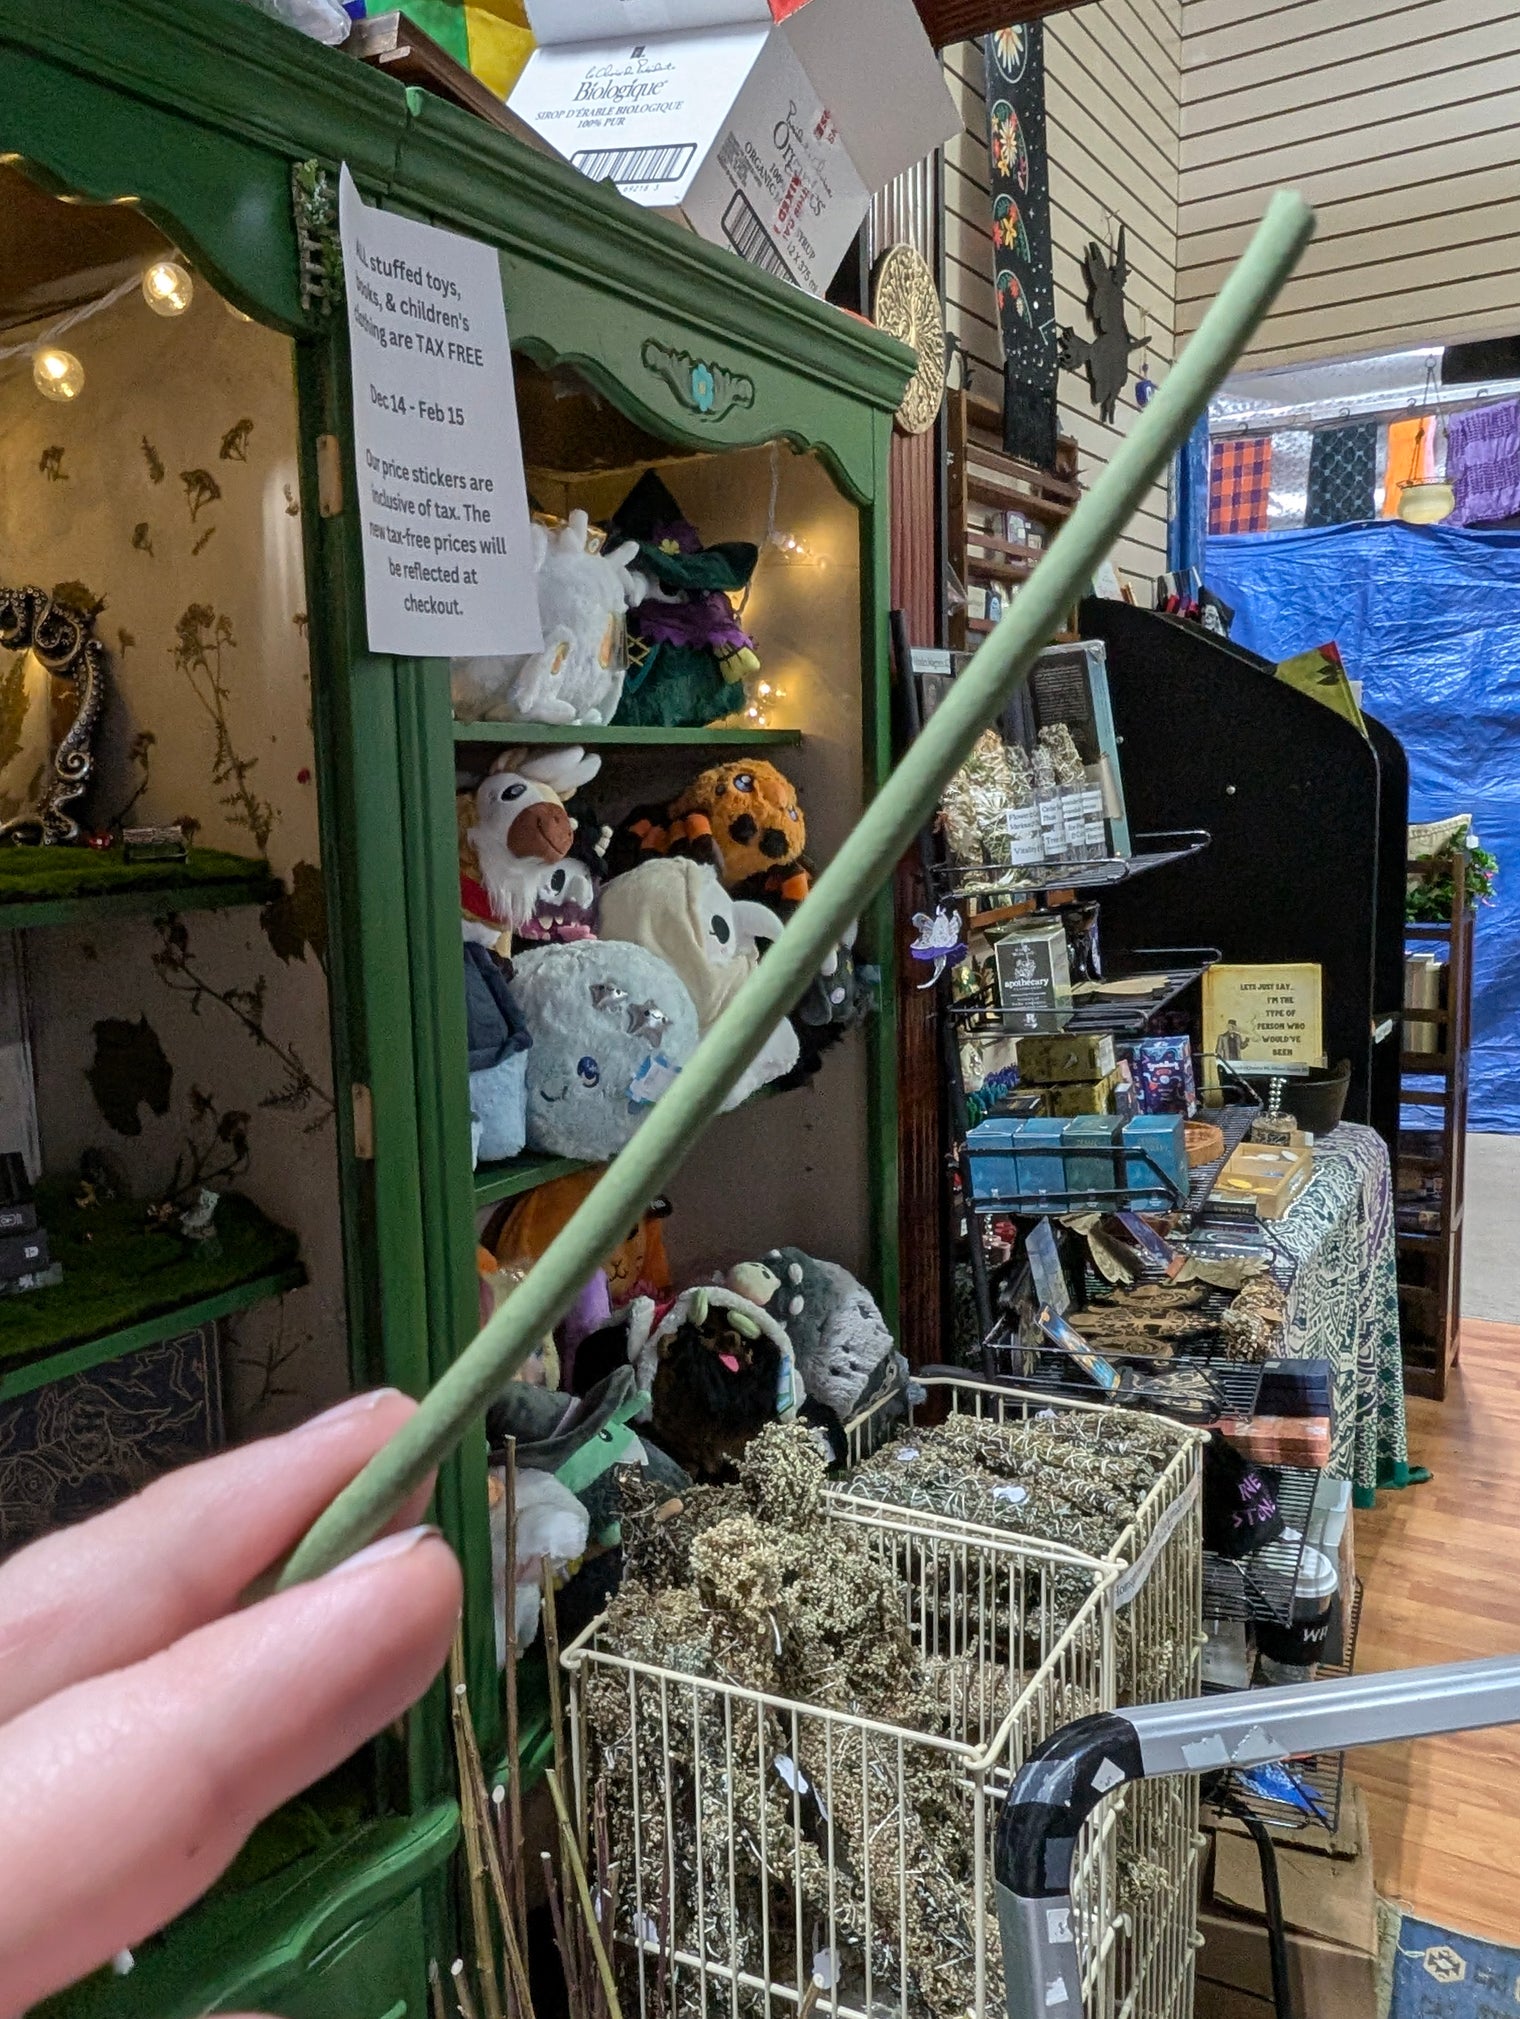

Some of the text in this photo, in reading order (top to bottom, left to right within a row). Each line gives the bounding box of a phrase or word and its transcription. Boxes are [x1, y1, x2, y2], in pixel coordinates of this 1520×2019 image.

[535, 100, 685, 120] SIROP D'ÉRABLE BIOLOGIQUE
[604, 116, 626, 127] PUR
[744, 141, 776, 196] ORGANIC
[773, 121, 826, 216] Orgcs
[370, 256, 423, 287] stuffed
[426, 271, 462, 302] toys,
[385, 292, 396, 313] &
[400, 297, 470, 332] children's
[389, 330, 413, 350] are
[416, 333, 445, 358] TAX
[448, 342, 484, 367] FREE
[370, 384, 390, 410] Dec
[390, 394, 406, 416] 14
[418, 400, 445, 422] Feb
[448, 406, 465, 426] 15
[366, 448, 494, 492] Our price stickers are
[371, 483, 491, 524] inclusive of tax. The
[369, 520, 508, 556] new tax-free prices will
[388, 557, 478, 585] be reflected at
[404, 593, 464, 616] checkout.
[1004, 978, 1050, 989] apothecary
[1280, 996, 1294, 1004] THE
[1257, 1022, 1306, 1030] PERSON WHO
[1262, 1035, 1302, 1043] WOULD'VE
